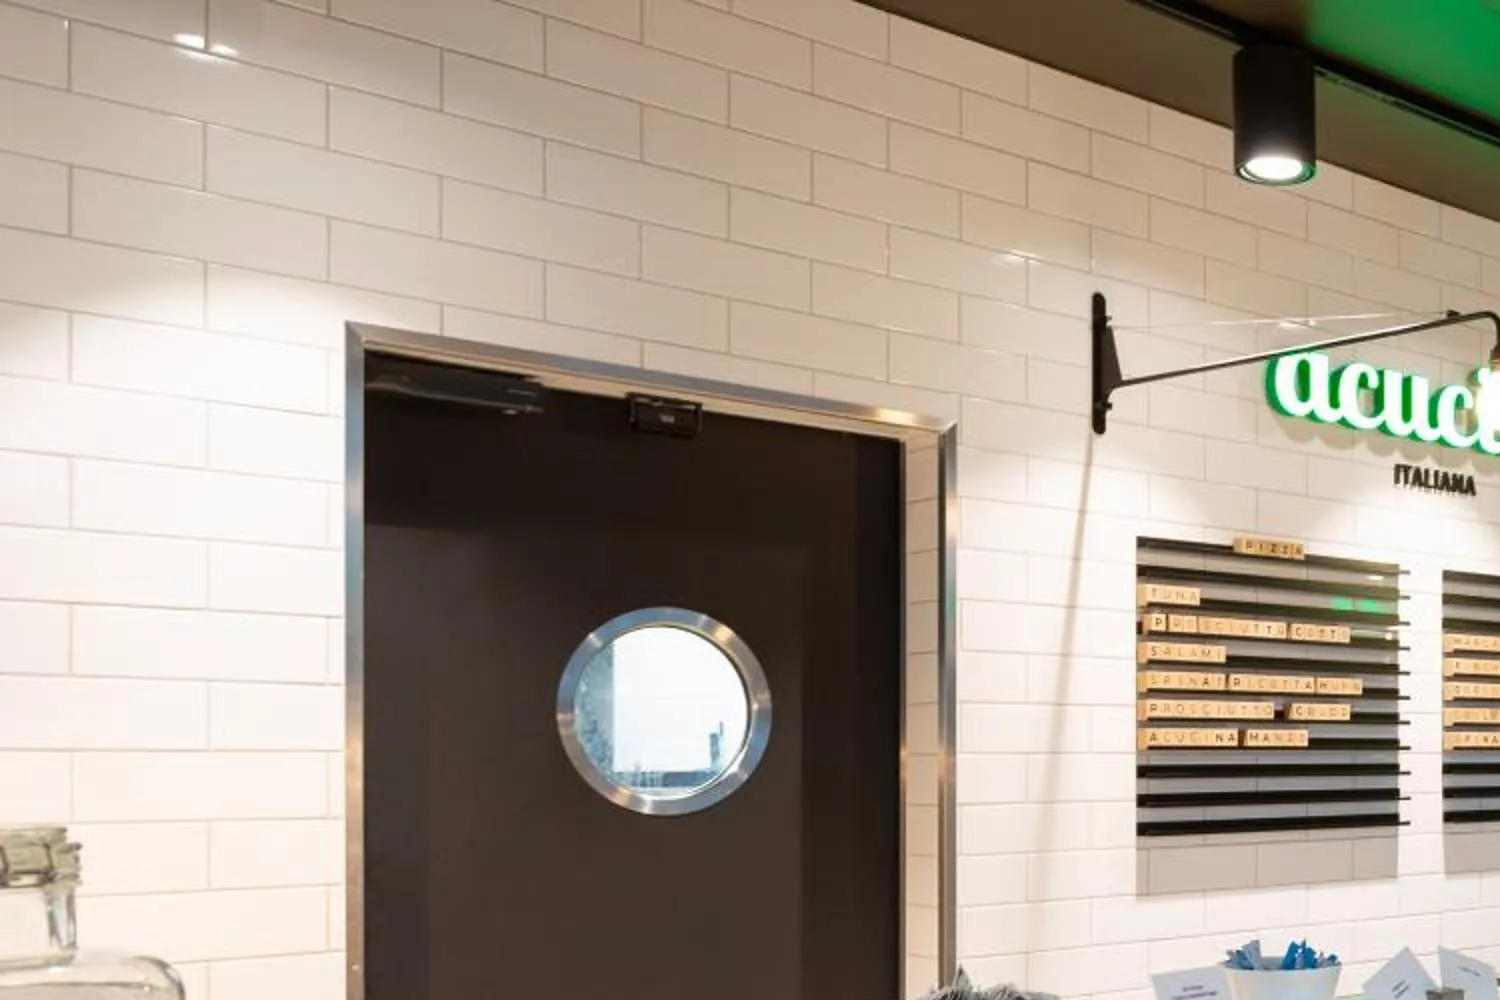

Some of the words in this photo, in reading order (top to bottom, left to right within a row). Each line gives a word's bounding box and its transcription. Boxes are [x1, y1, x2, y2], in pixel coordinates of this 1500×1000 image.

[1393, 463, 1477, 496] ITALIANA
[1245, 540, 1303, 556] PIZZA
[1150, 645, 1221, 659] SALAMI
